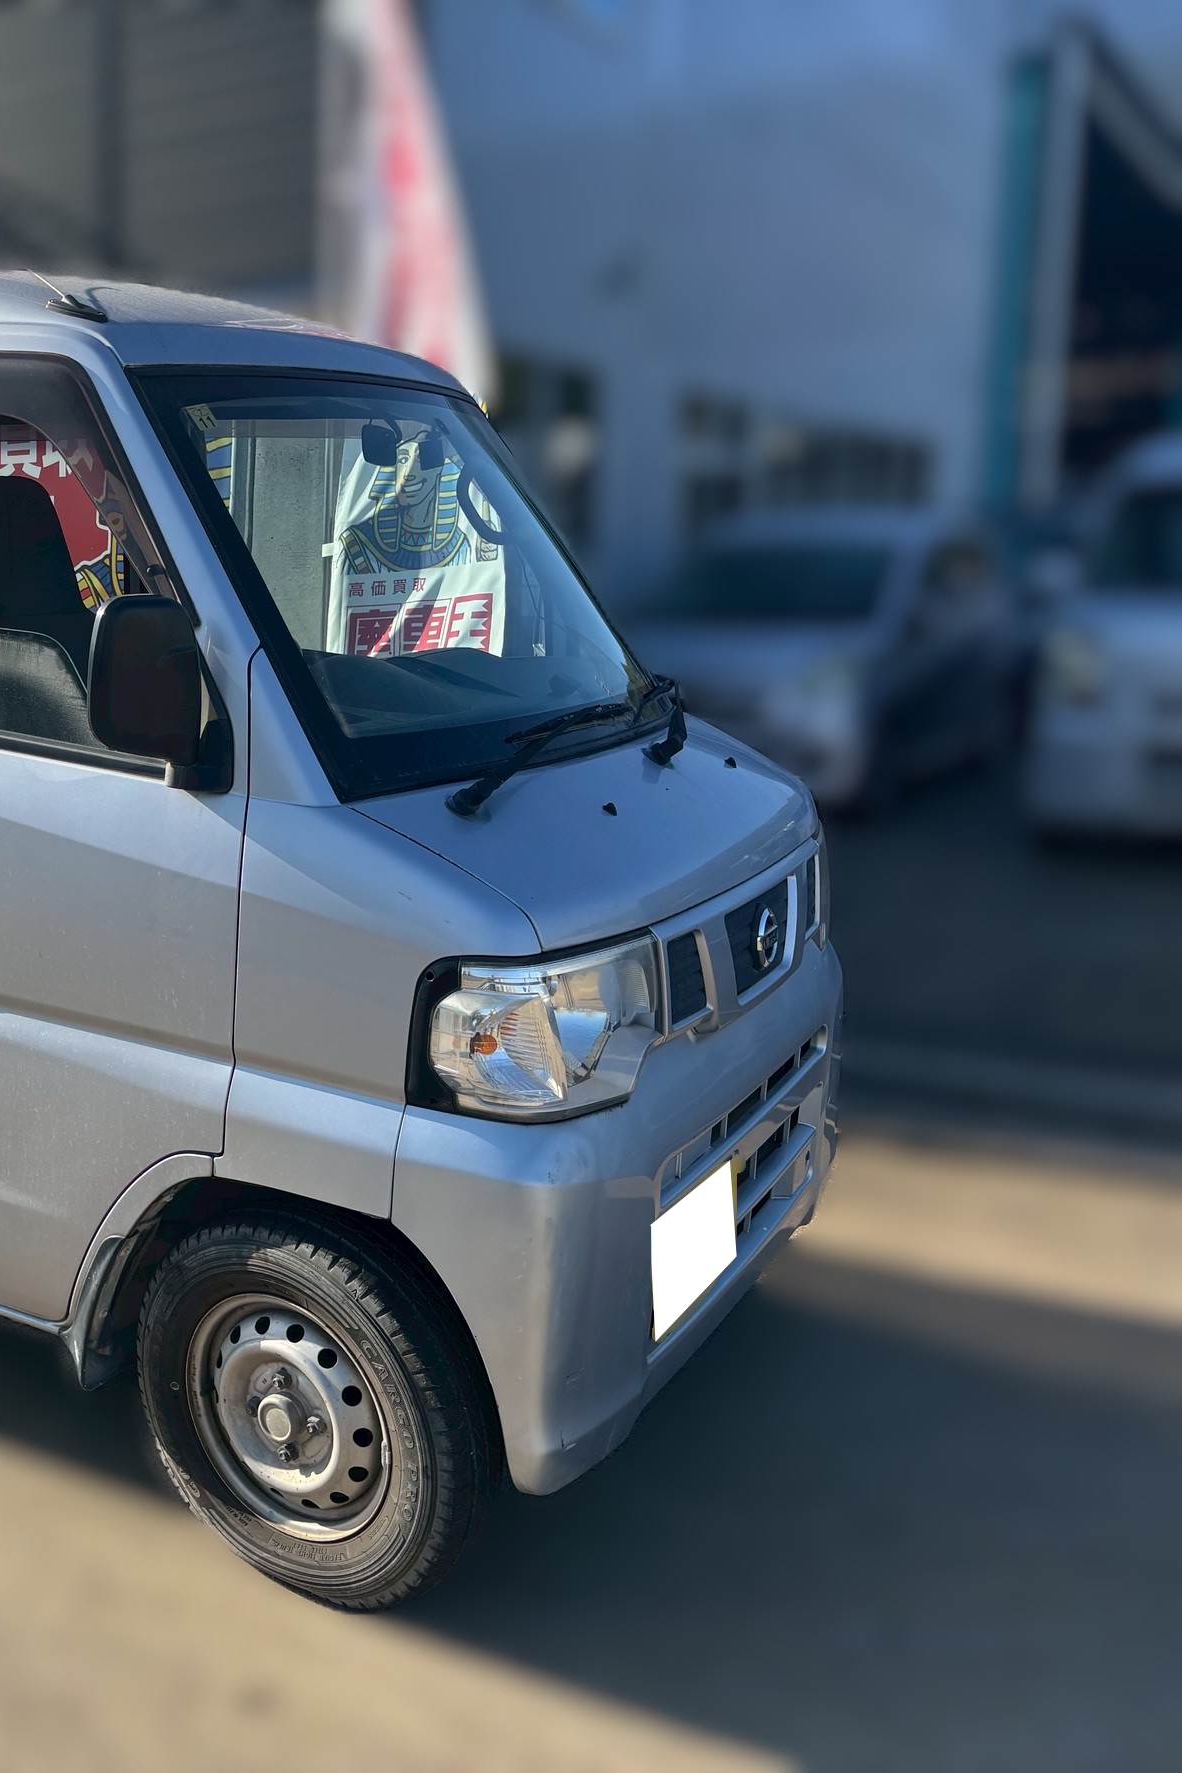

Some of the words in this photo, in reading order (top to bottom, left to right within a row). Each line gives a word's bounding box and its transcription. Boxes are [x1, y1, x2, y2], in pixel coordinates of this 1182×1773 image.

[198, 415, 216, 428] 11
[349, 577, 427, 598] 高価買取
[360, 1339, 415, 1449] CARGO
[396, 1462, 418, 1522] PRO
